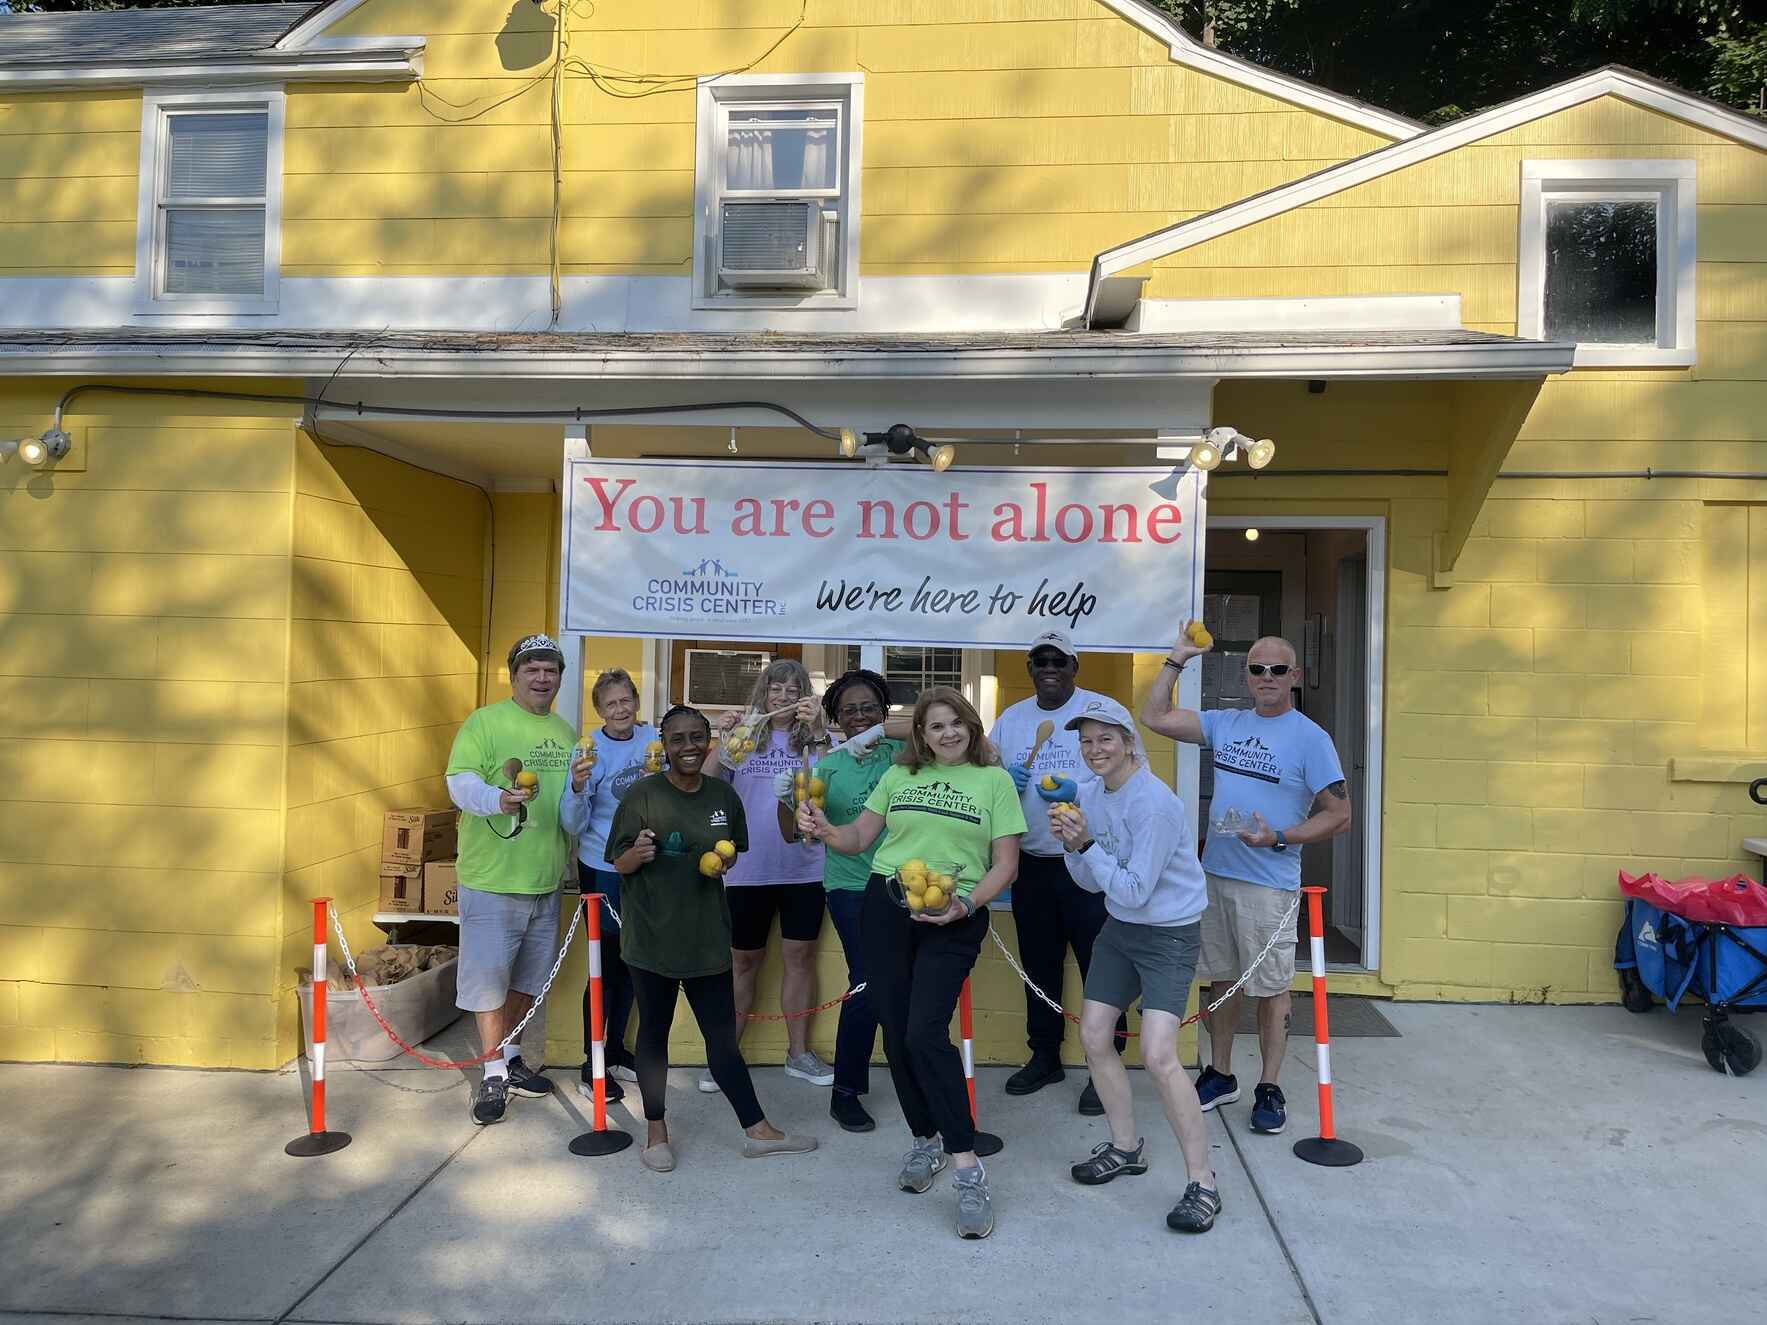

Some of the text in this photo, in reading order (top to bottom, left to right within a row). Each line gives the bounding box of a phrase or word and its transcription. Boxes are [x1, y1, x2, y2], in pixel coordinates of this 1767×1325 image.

[583, 477, 1183, 545] You are not alone
[647, 578, 764, 598] COMMUNITY
[632, 595, 777, 616] CRISIS CENTER
[815, 575, 1099, 630] We're here to help
[1213, 750, 1238, 765] RISIS
[1238, 758, 1278, 775] CENTER
[1222, 743, 1277, 763] COMMUNITY
[741, 766, 771, 776] CRISIS
[749, 759, 804, 768] COMMUNITY
[1038, 759, 1077, 770] CENTER
[891, 795, 924, 805] CRISIS
[927, 798, 978, 815] CENTER
[902, 787, 974, 803] COMMUNITY
[443, 889, 458, 906] Sil
